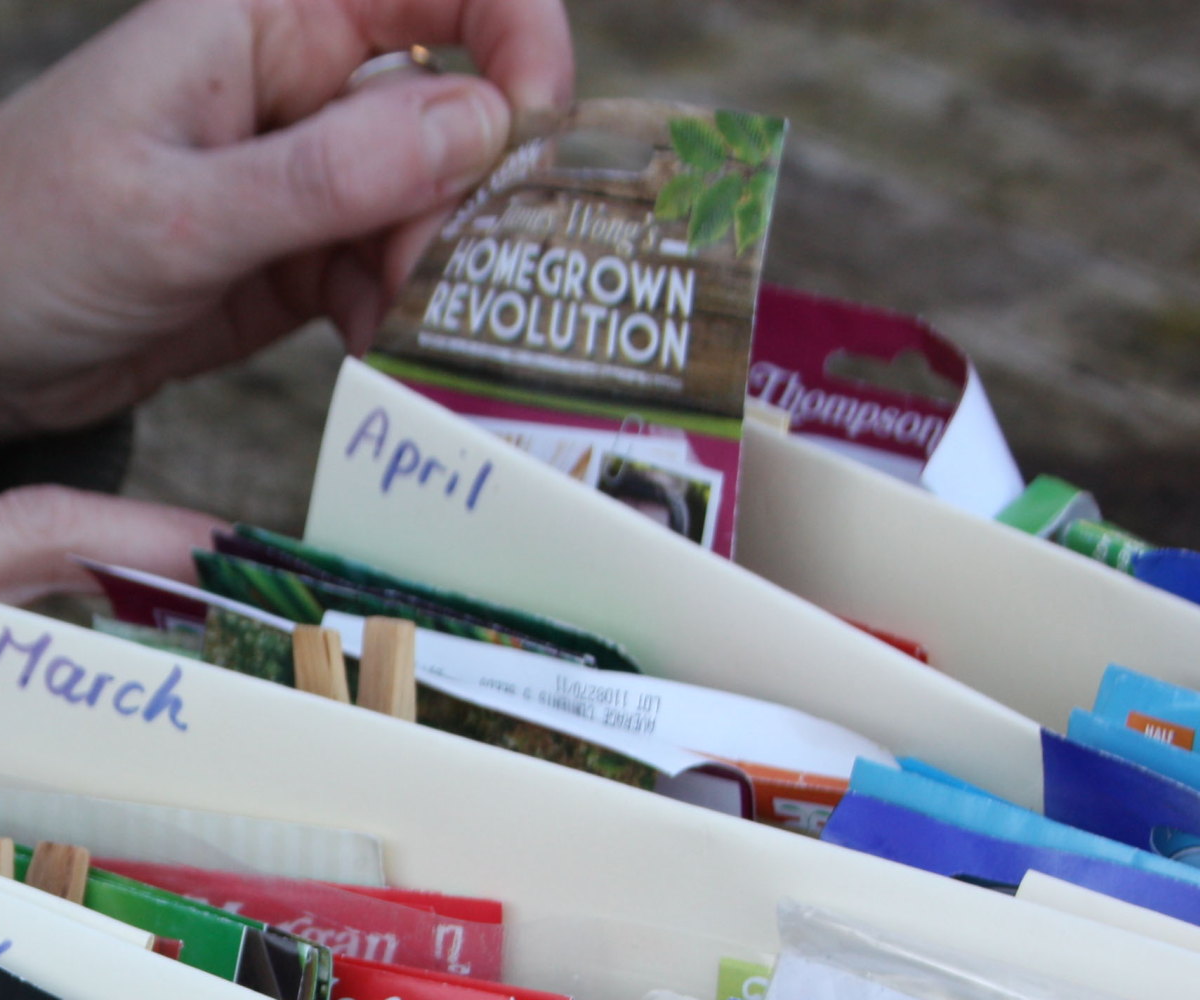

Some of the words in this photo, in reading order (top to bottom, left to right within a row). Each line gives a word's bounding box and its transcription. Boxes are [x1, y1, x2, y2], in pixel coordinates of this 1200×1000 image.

[443, 237, 696, 318] HOMEGROWN
[422, 281, 690, 370] REVOLUTION
[749, 360, 947, 457] Thompson
[343, 405, 495, 513] April
